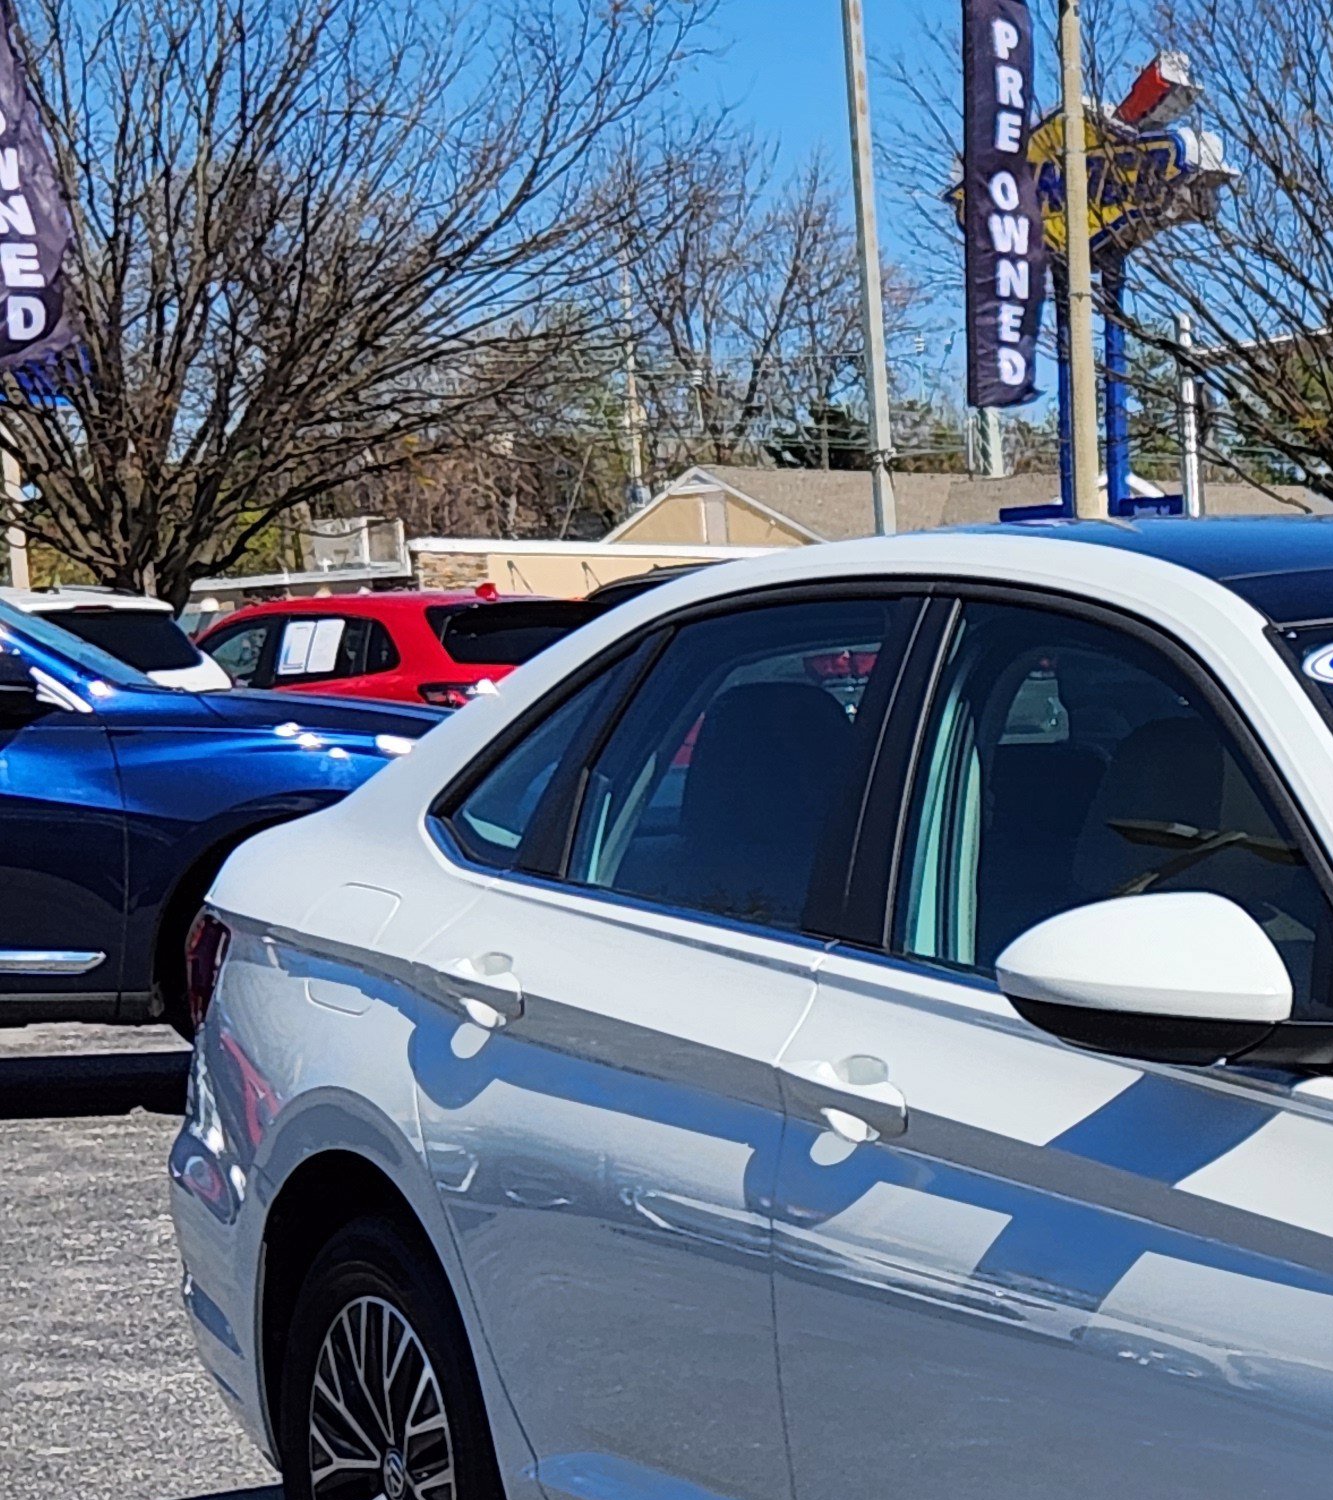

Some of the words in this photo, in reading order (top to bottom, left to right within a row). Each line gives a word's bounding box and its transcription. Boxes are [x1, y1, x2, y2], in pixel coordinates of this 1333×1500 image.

[991, 18, 1024, 153] PRE
[0, 110, 46, 341] NED
[987, 170, 1029, 386] OWNED
